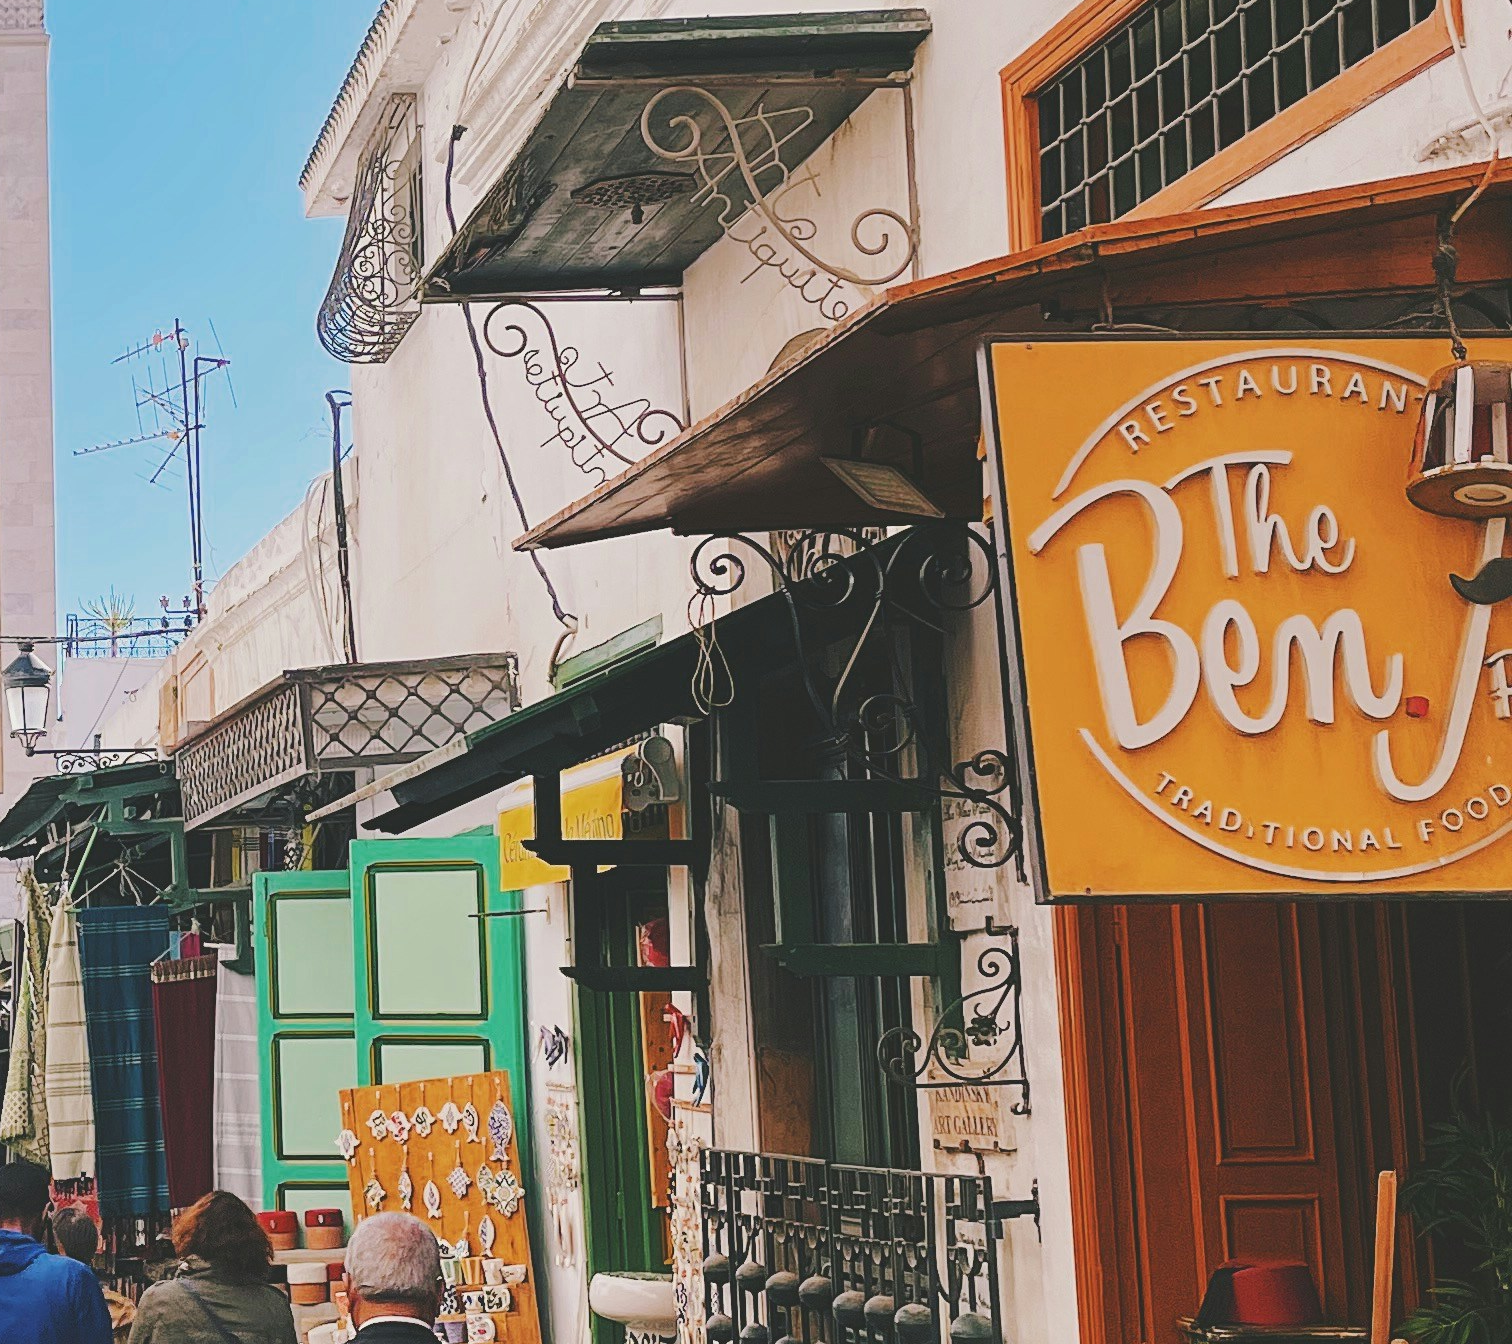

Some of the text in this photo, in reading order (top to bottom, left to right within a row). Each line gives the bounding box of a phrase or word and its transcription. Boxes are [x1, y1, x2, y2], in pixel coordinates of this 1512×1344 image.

[676, 147, 849, 321] Antiquite
[1118, 363, 1426, 453] RESTAURAN
[1164, 450, 1356, 579] The
[1416, 783, 1512, 843] FOOD
[934, 1115, 998, 1137] ART GALLERY
